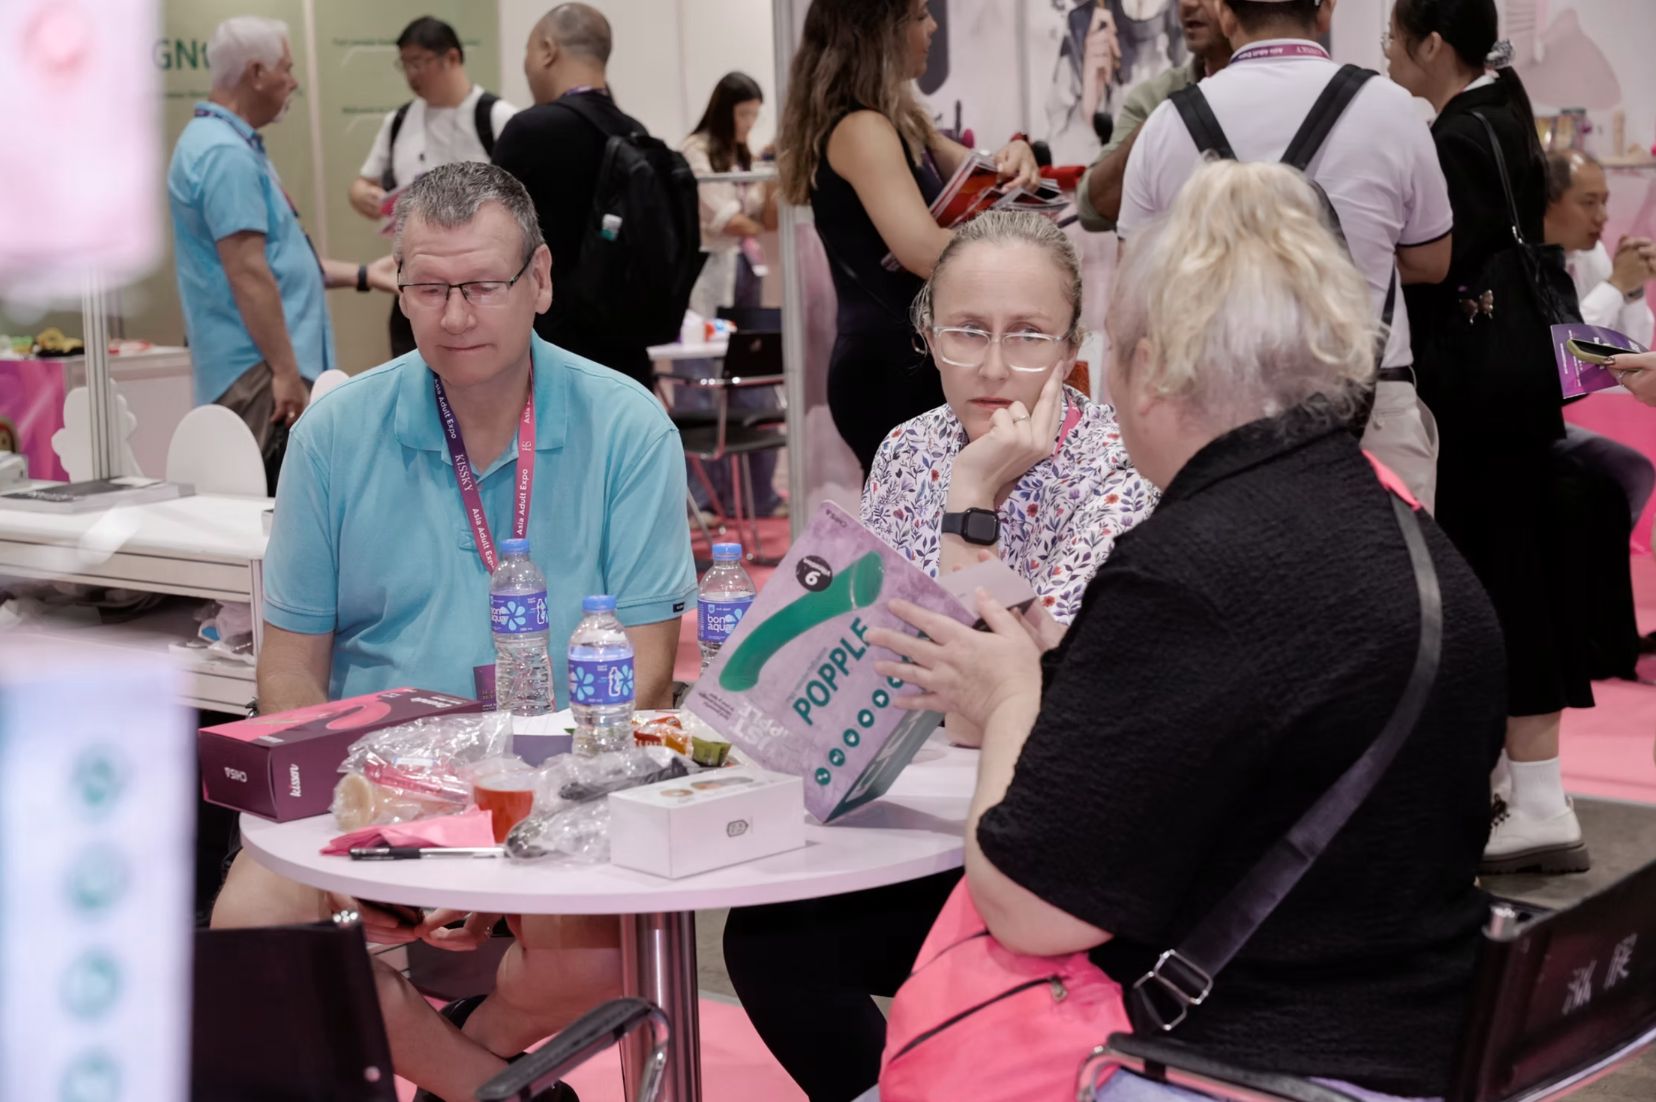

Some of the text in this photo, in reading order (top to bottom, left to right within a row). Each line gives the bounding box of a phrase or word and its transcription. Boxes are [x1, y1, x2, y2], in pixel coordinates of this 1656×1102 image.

[438, 396, 452, 419] Adult
[447, 418, 457, 439] Expo
[454, 454, 474, 491] KISSKY
[516, 468, 530, 535] Asia Adult Expo
[472, 508, 483, 526] Asia
[478, 527, 491, 550] Adult
[804, 570, 821, 586] 6
[707, 613, 726, 624] bon
[792, 617, 870, 726] POPPLE
